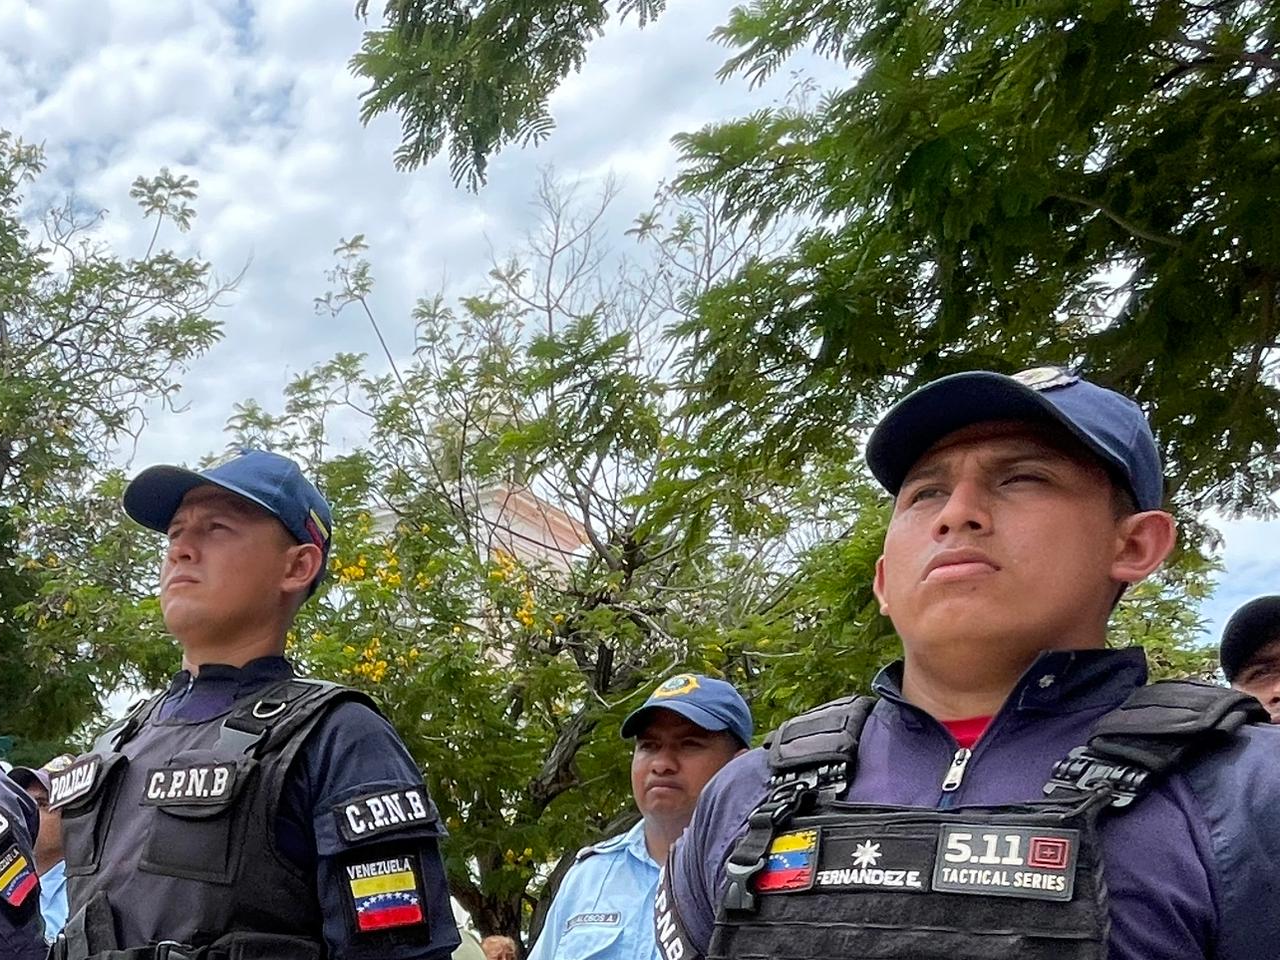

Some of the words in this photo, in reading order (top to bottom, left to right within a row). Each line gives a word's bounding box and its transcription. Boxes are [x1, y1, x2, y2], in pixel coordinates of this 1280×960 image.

[49, 762, 95, 803] POLICIA
[147, 768, 228, 799] C.P.N.B
[346, 791, 426, 834] C.P.N.B
[944, 832, 1024, 865] 5.11
[346, 858, 412, 880] VENEZUELA
[942, 868, 1010, 886] TACTICAL
[1013, 872, 1065, 892] SERIES
